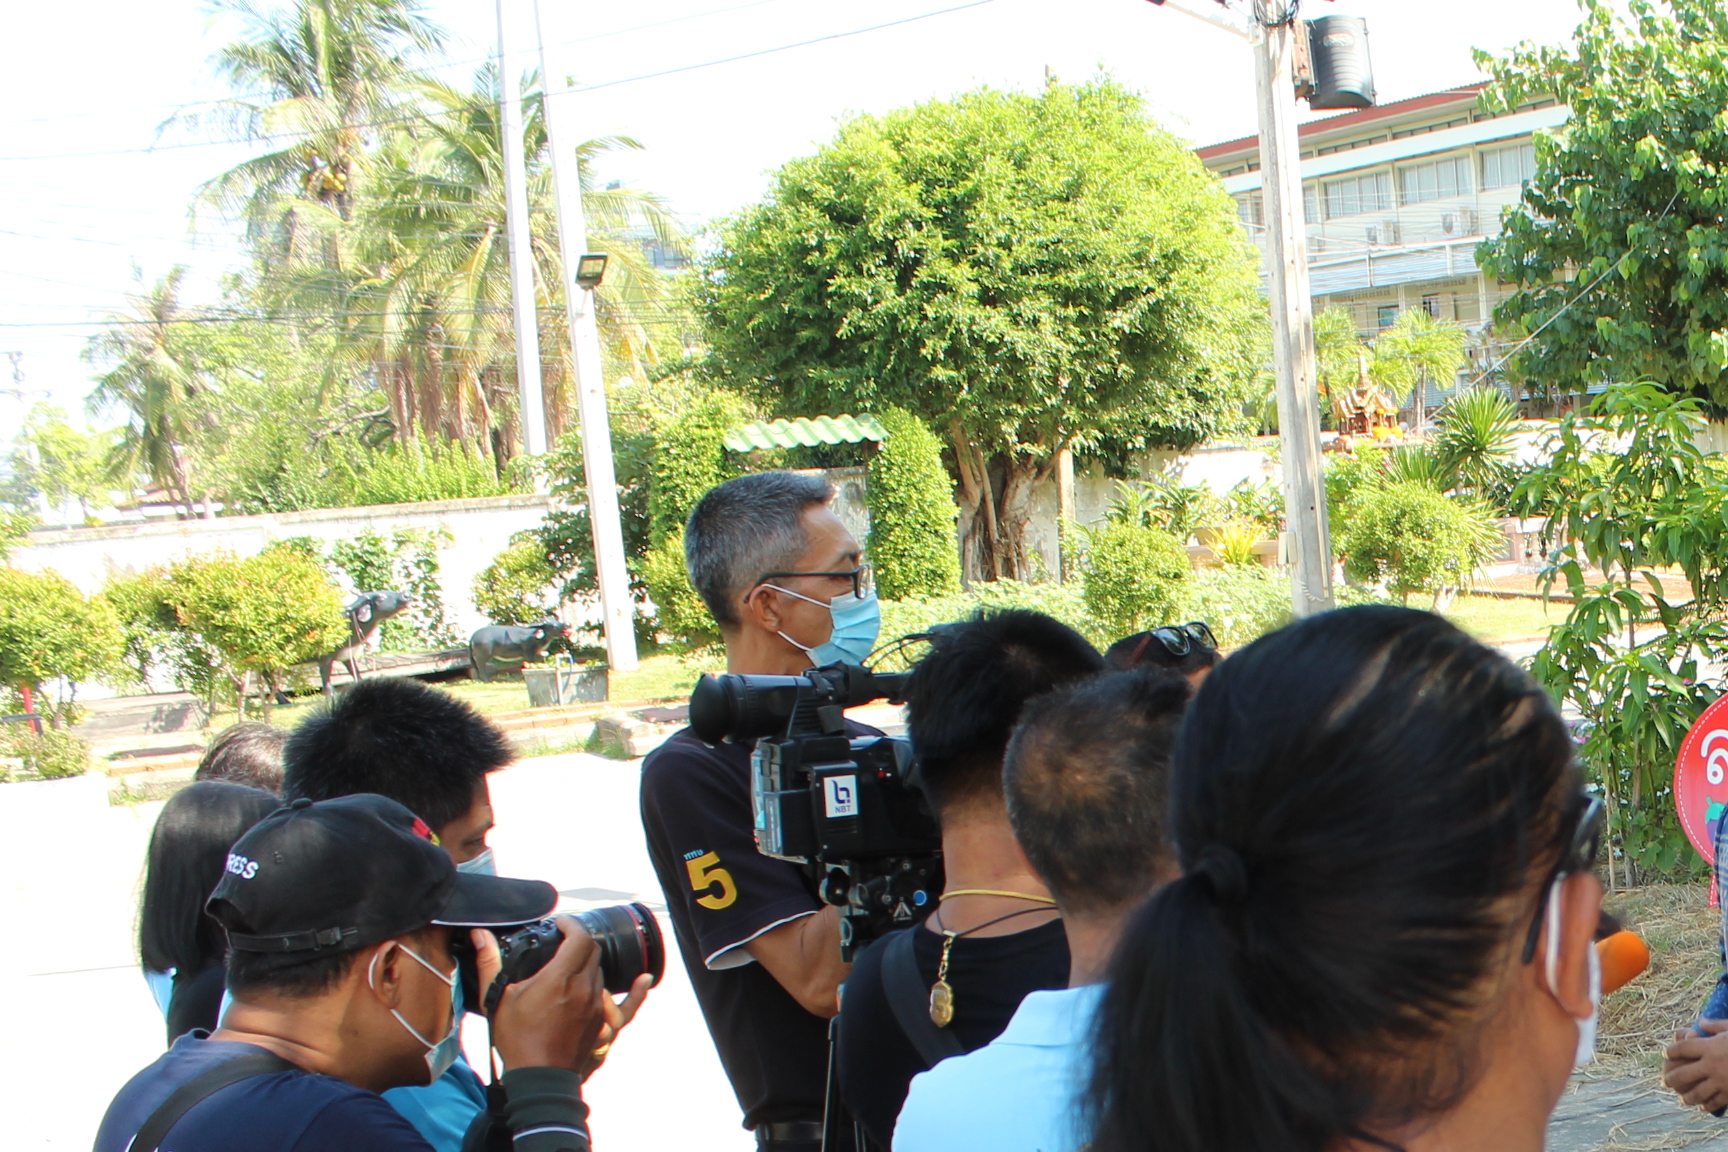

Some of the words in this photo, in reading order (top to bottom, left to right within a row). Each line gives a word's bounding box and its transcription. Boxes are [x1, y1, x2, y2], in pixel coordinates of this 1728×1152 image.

[834, 805, 852, 814] NBT
[226, 853, 259, 880] RESS
[686, 850, 738, 911] 5
